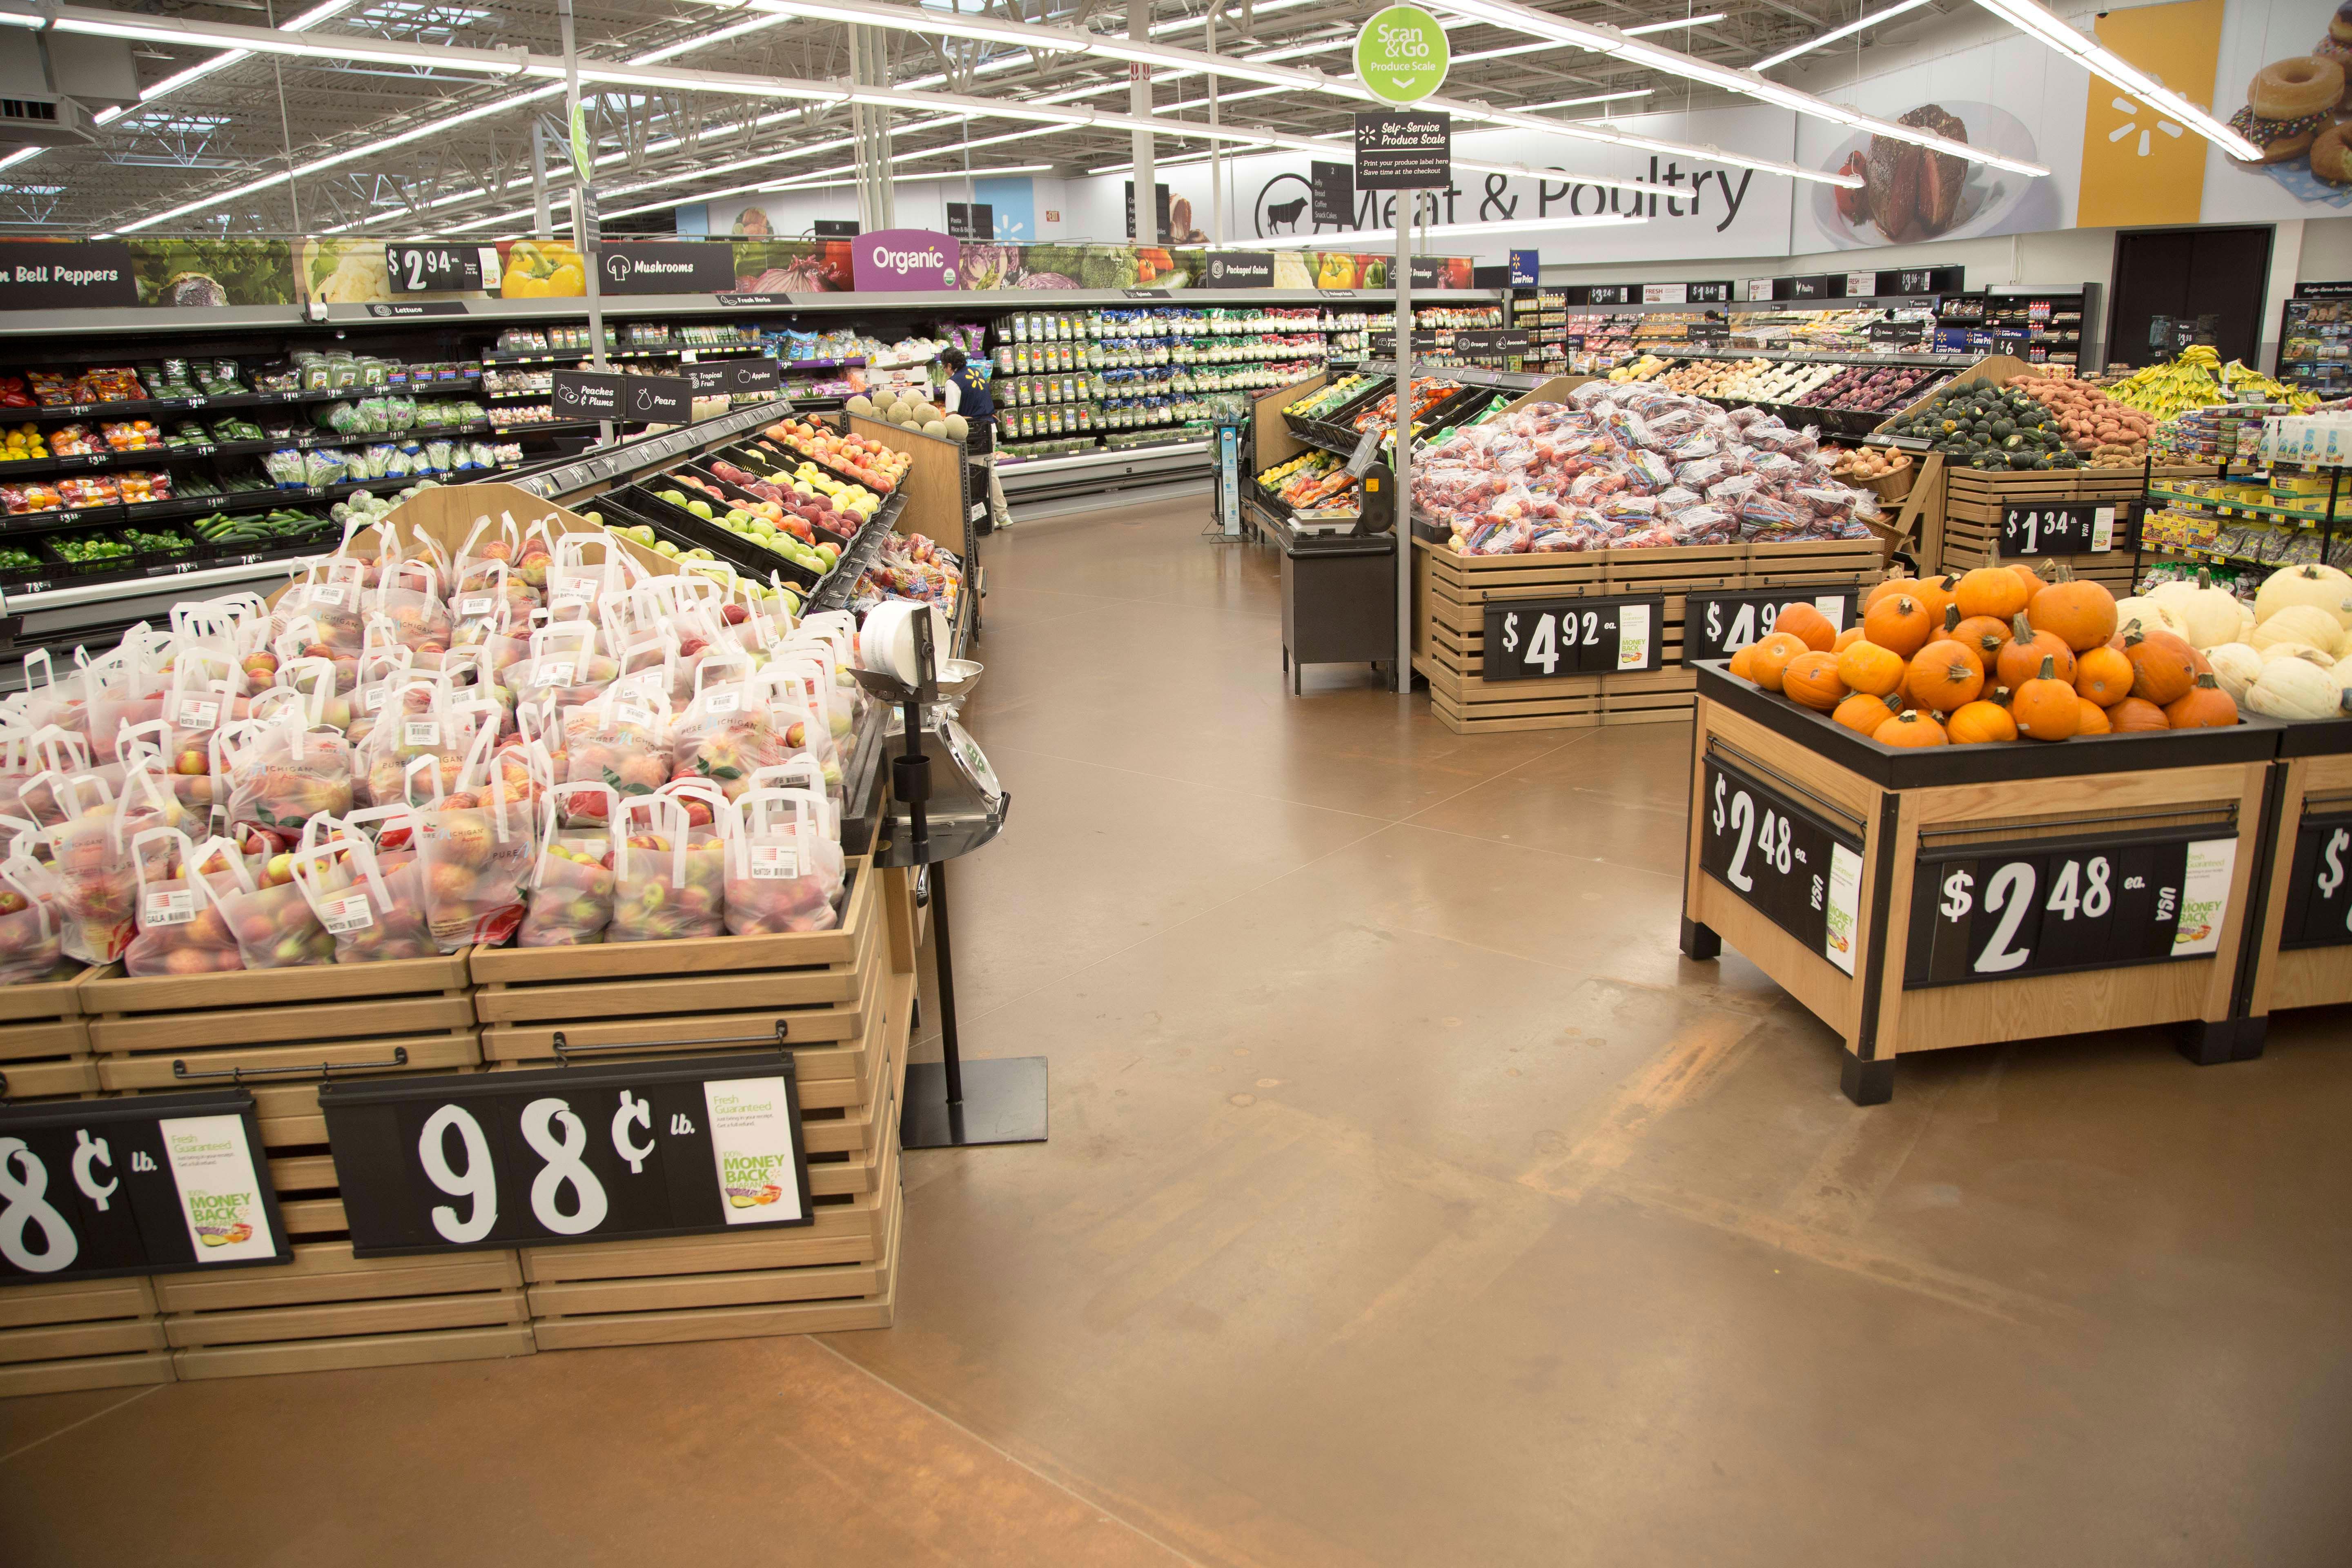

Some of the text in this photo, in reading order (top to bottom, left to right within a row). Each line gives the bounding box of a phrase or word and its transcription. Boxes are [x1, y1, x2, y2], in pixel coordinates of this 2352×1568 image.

[1377, 24, 1423, 43] Scan
[1385, 38, 1429, 58] & Go
[1371, 61, 1436, 71] Produce Scale
[1381, 122, 1440, 134] Self-Service
[1381, 133, 1446, 145] Produce Scale
[1314, 179, 1323, 187] Jelly
[1479, 173, 1518, 222] &
[1539, 156, 1753, 233] Poultry
[635, 260, 693, 273] Mushrooms
[873, 246, 944, 274] Organic
[16, 265, 118, 286] Bell Peppers
[1226, 265, 1268, 276] Packaged Salads
[1413, 268, 1432, 279] Dressings
[1512, 274, 1534, 284] Low Price
[1902, 273, 1918, 291] $396
[700, 372, 722, 380] Tropical
[752, 372, 770, 380] Apples
[581, 385, 614, 396] Peaches
[581, 394, 614, 407] & Plums
[654, 396, 676, 406] Pears
[1713, 773, 1791, 892] $248
[1795, 848, 1807, 864] ea.
[493, 849, 518, 859] PURE
[1811, 874, 1824, 911] USA
[2156, 886, 2176, 922] USA
[2181, 900, 2222, 913] MONEY
[147, 914, 166, 924] GALA
[1829, 904, 1853, 927] MONEY
[1940, 856, 2145, 973] $248 ea.
[2179, 912, 2208, 923] BACK
[1829, 914, 1846, 931] BACK
[714, 1095, 739, 1105] Fresh
[715, 1101, 772, 1115] Guaranteed
[171, 1134, 198, 1144] Fresh
[174, 1140, 232, 1153] Guaranteed
[131, 1151, 158, 1172] lb.
[419, 1089, 695, 1244] 98¢ lb.
[723, 1154, 785, 1170] MONEY
[724, 1168, 770, 1183] BACK
[189, 1192, 252, 1209] MONEY
[192, 1207, 238, 1222] BACK
